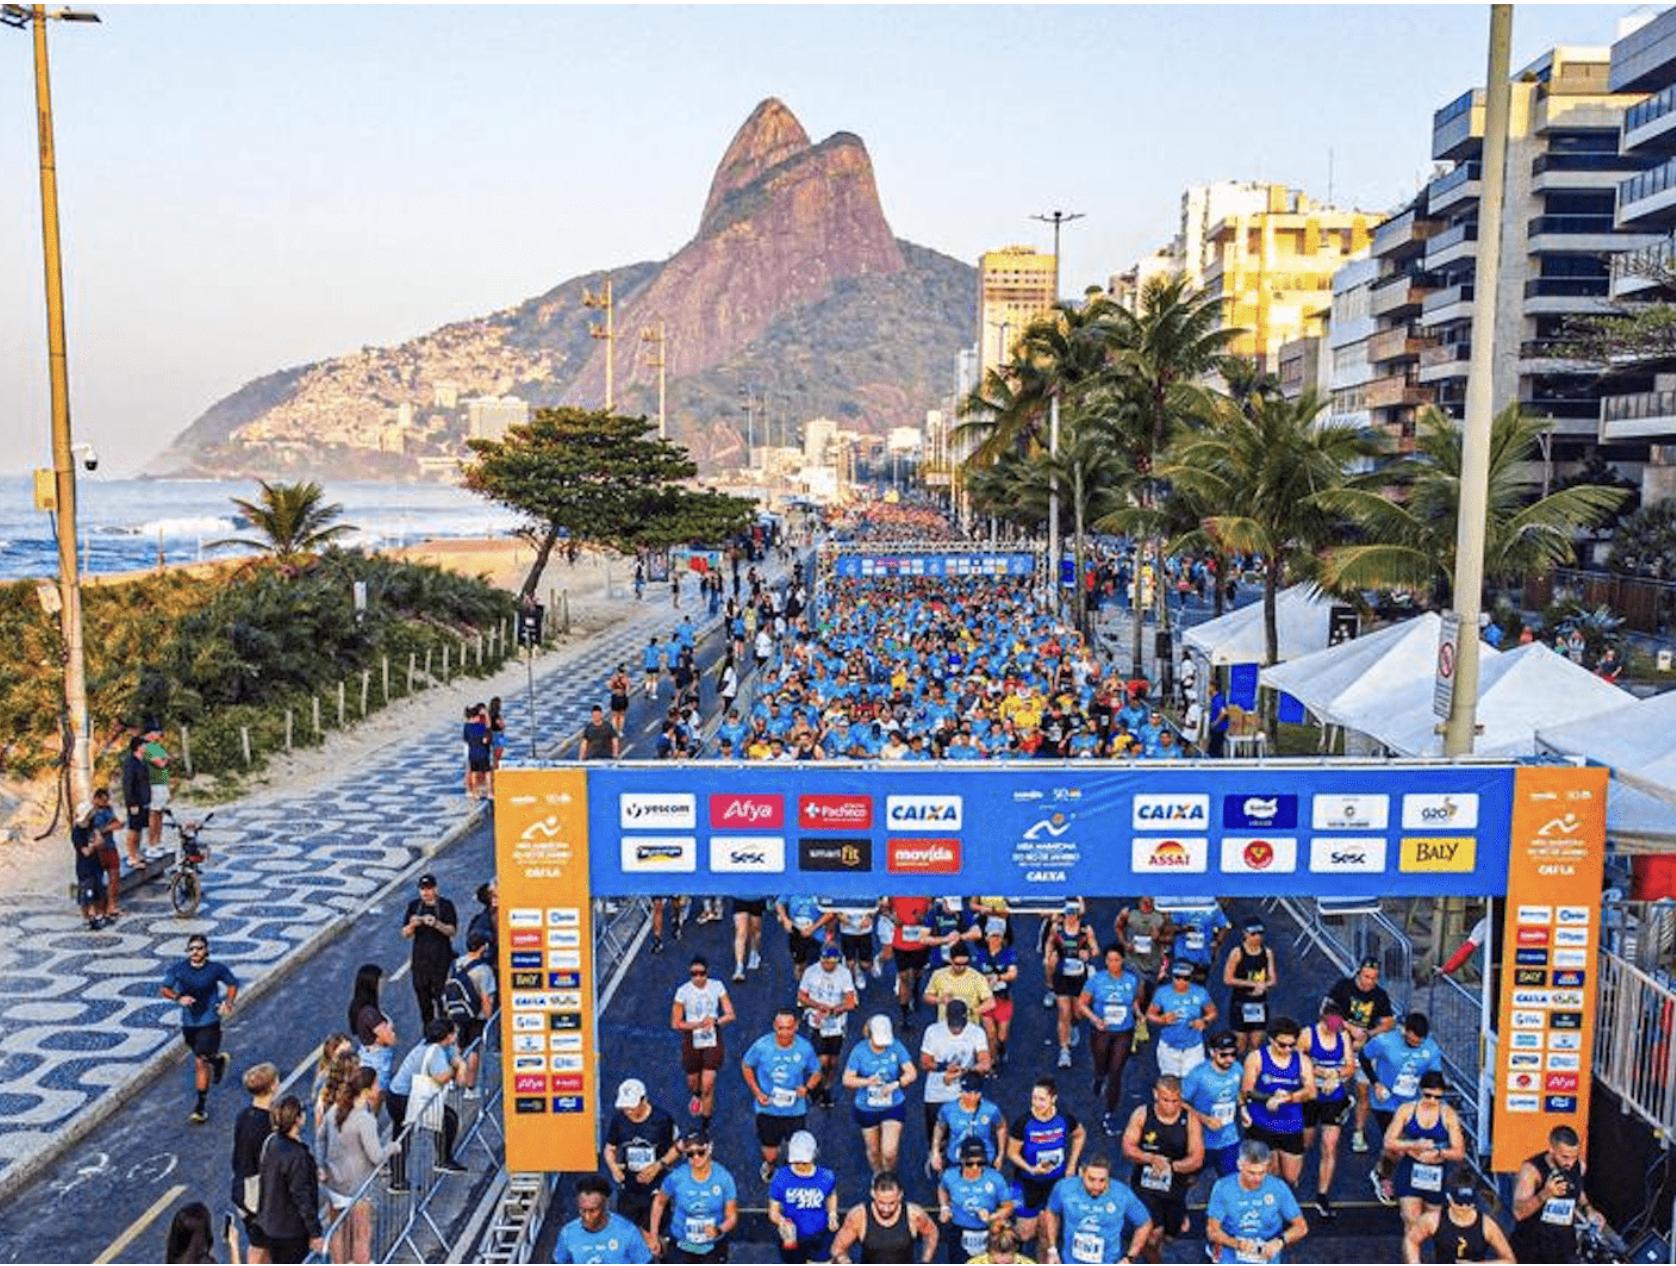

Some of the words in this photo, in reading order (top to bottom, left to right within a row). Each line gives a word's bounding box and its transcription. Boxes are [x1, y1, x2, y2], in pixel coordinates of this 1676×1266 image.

[644, 804, 689, 815] yescom
[723, 800, 773, 822] Afya
[822, 805, 867, 817] Pacheco
[892, 805, 957, 821] CAIXA
[1138, 805, 1204, 820] CAIXA
[895, 845, 953, 862] movida
[1416, 842, 1459, 863] BALY
[1026, 871, 1066, 882] CAIXA
